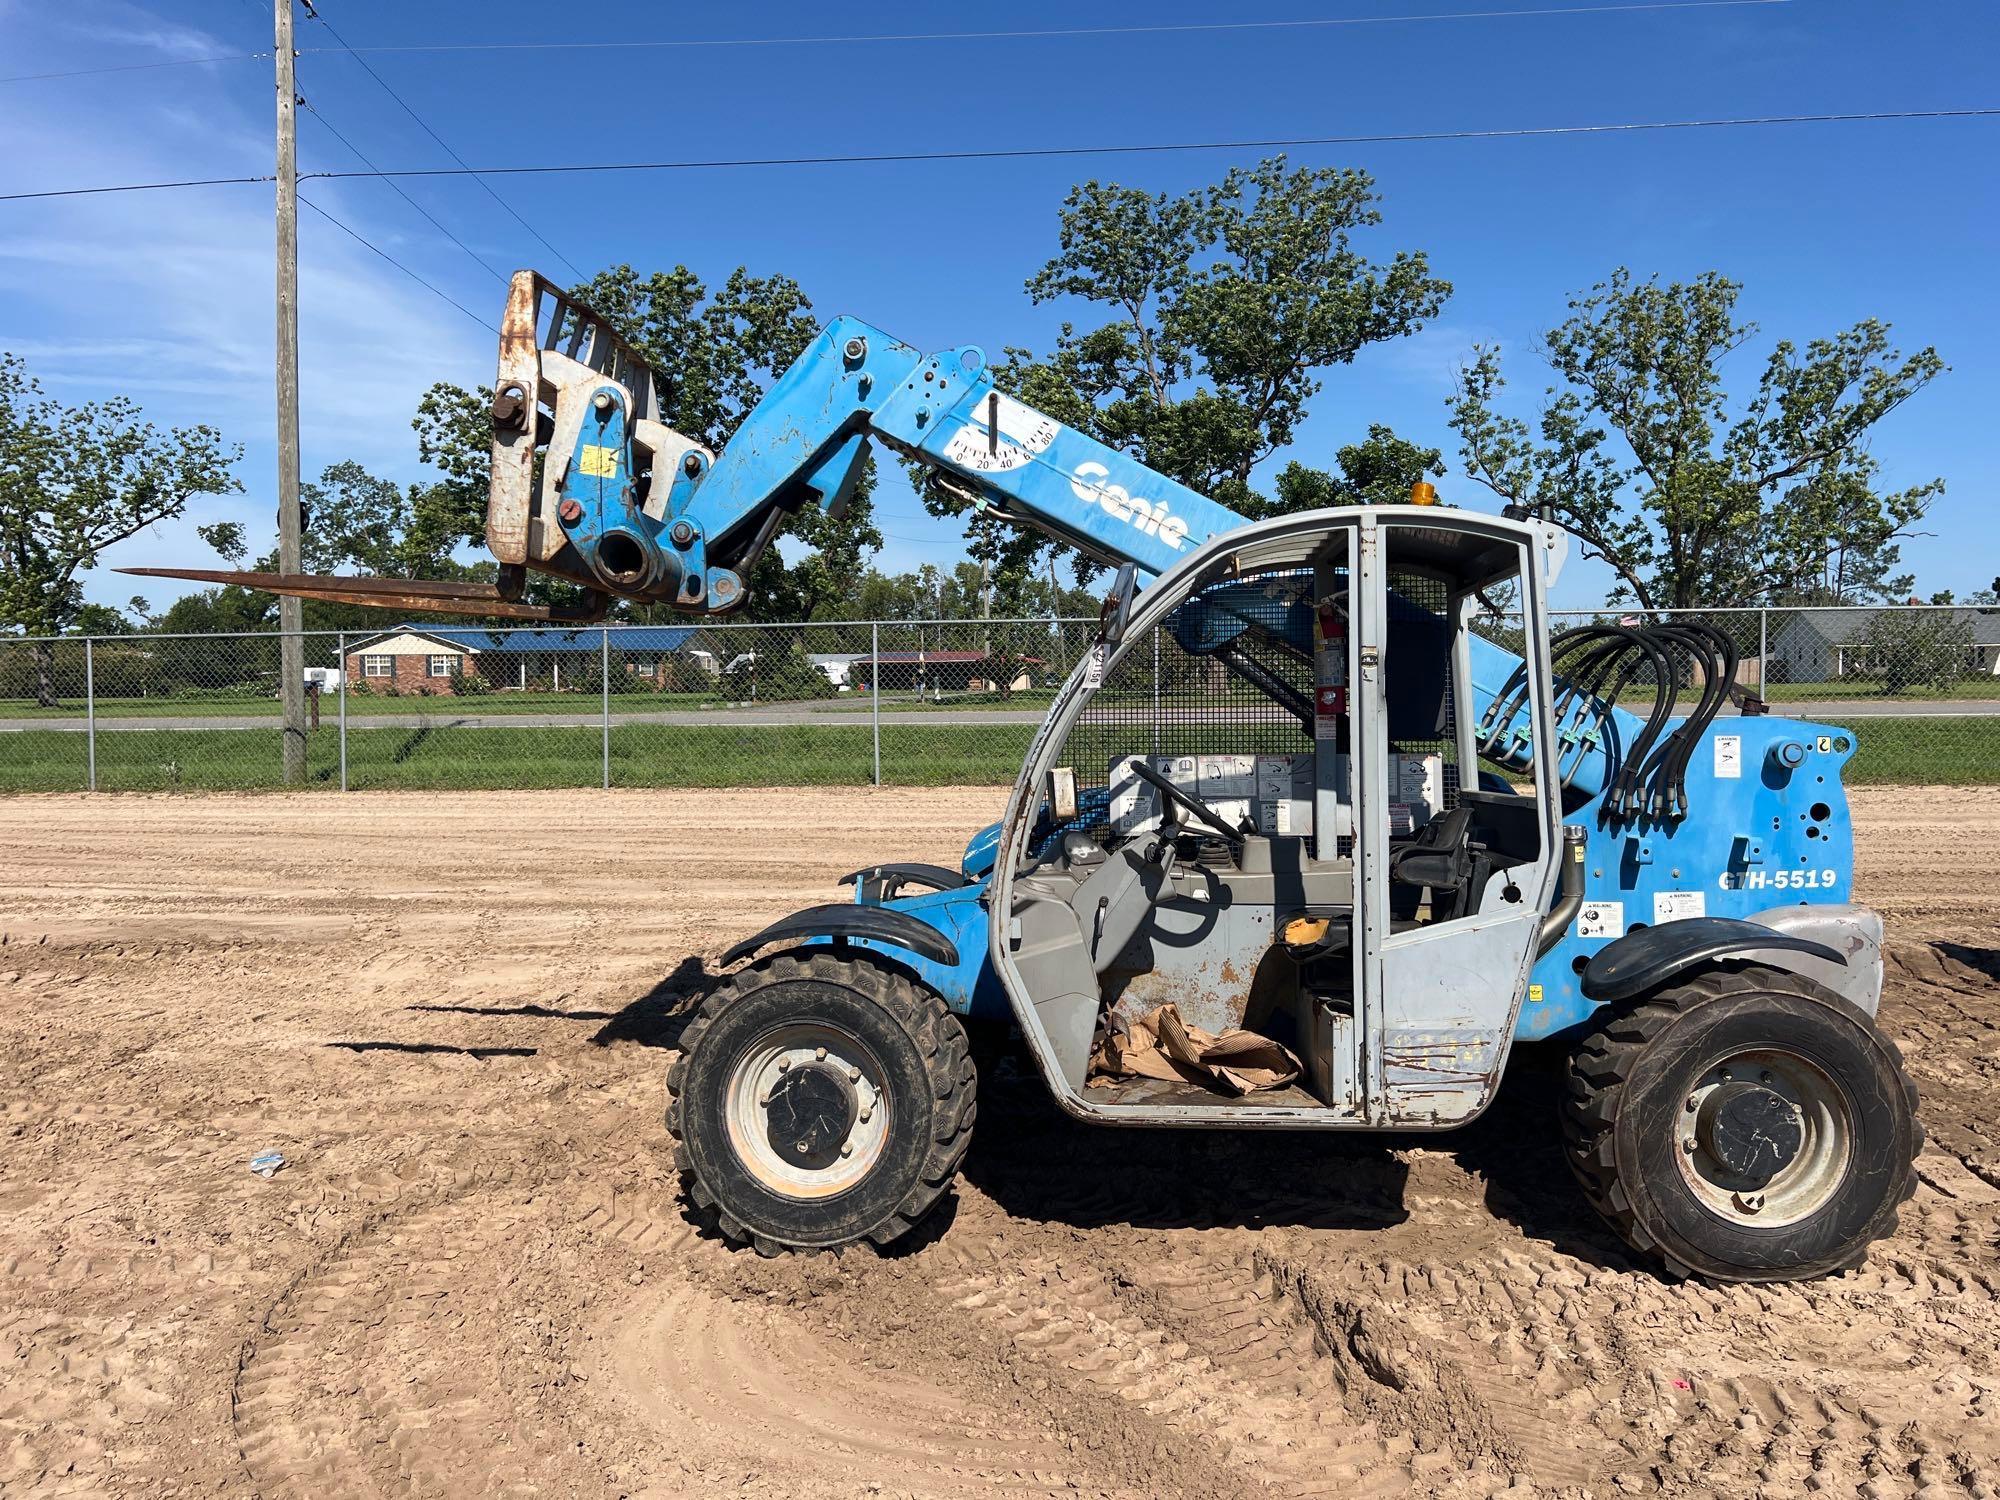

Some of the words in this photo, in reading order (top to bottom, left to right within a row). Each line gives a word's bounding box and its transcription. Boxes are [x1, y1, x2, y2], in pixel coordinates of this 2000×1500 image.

[1070, 462, 1189, 550] Genie
[1089, 653, 1106, 684] 221150
[1718, 869, 1837, 891] GTH-5519
